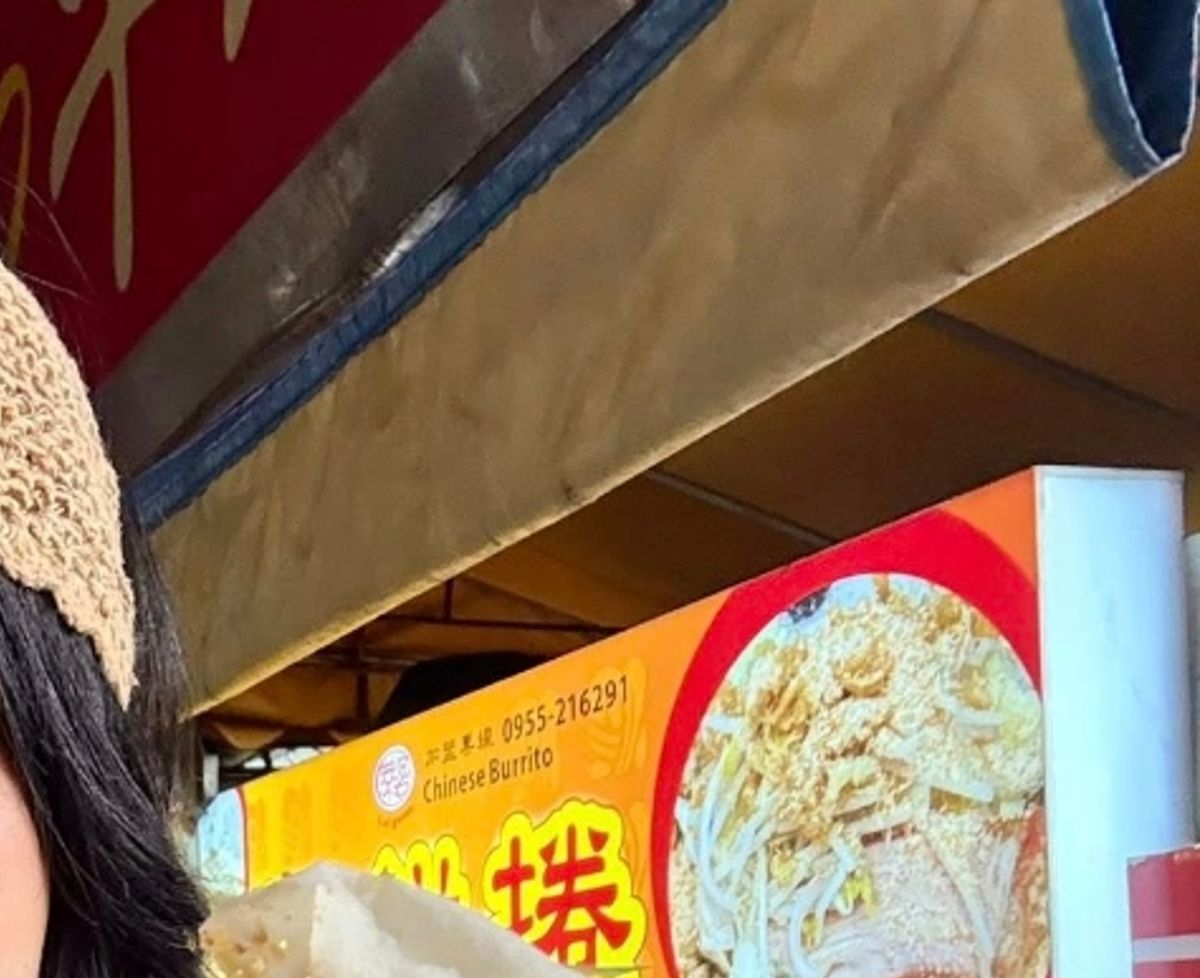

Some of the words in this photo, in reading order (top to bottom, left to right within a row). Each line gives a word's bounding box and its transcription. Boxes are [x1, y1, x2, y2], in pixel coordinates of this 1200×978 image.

[502, 676, 628, 743] 0955-216291
[423, 766, 486, 802] Chinese
[488, 746, 554, 784] Burrito
